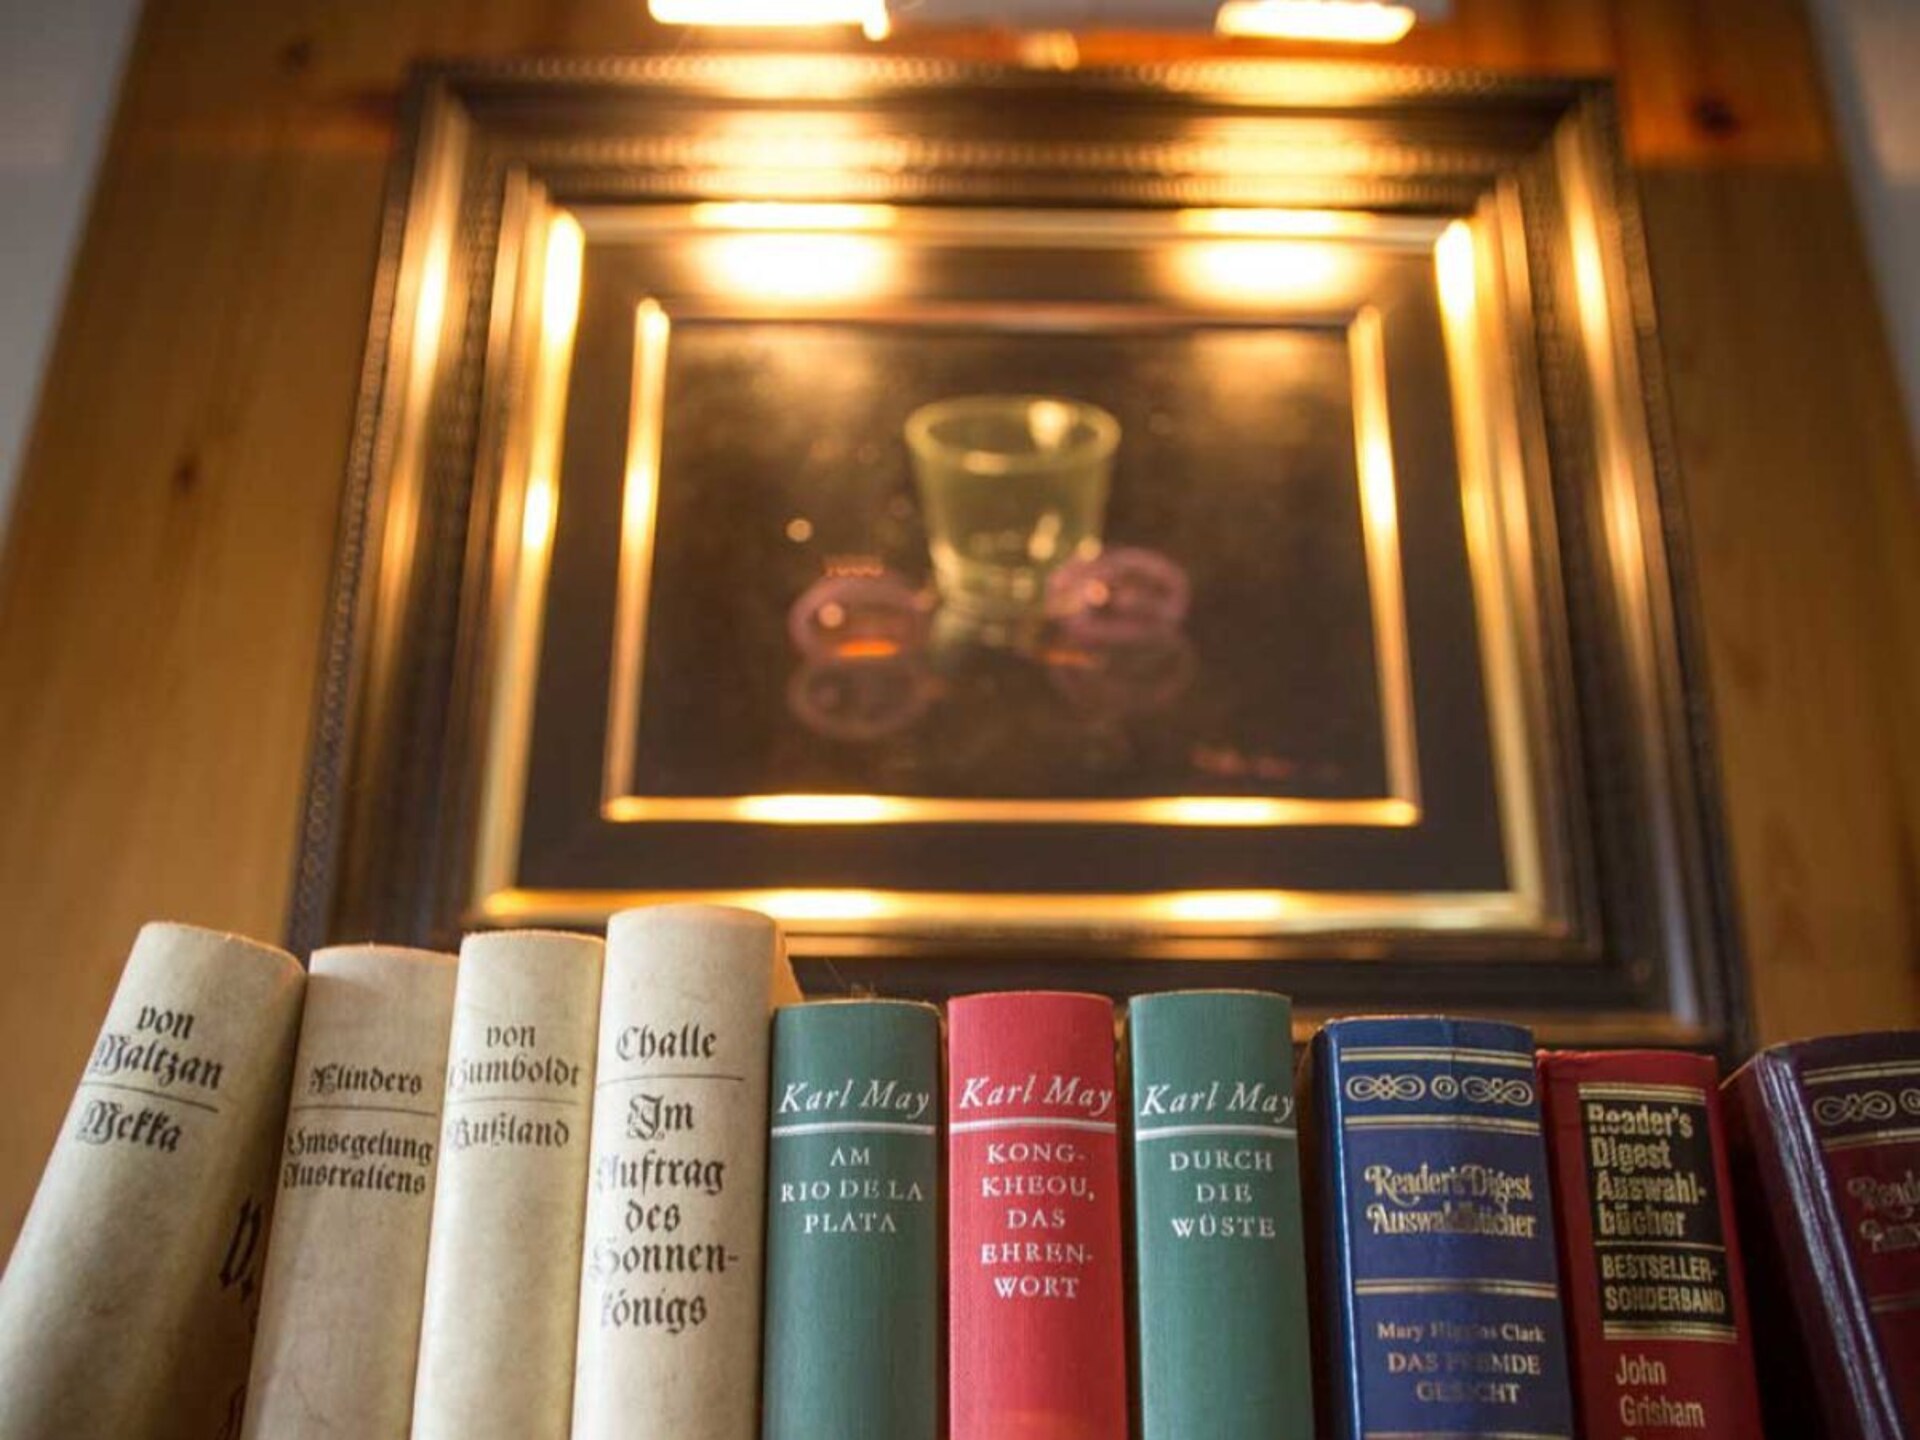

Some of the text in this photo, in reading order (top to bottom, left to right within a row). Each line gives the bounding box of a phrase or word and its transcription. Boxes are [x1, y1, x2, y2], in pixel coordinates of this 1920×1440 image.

[136, 1005, 195, 1041] von
[486, 1025, 536, 1048] von
[616, 1024, 717, 1062] Challe
[90, 1033, 223, 1090] Maltzan
[308, 1062, 423, 1096] Flinders
[958, 1074, 1113, 1117] Karl May
[777, 1078, 930, 1119] Karl May
[1139, 1080, 1295, 1124] Karl May
[75, 1099, 182, 1154] Mekka
[627, 1093, 694, 1141] Im
[1587, 1102, 1694, 1139] Reader's
[829, 1146, 871, 1167] AM
[987, 1142, 1087, 1165] KONG-
[1169, 1150, 1274, 1173] DURCH
[1590, 1134, 1673, 1173] Digest
[781, 1178, 925, 1203] RIO DE LA
[1196, 1182, 1253, 1203] DIE
[1461, 1162, 1533, 1214] Digest
[1596, 1169, 1708, 1204] Auswahl-
[625, 1199, 681, 1233] des
[803, 1212, 897, 1235] PLATA
[1007, 1207, 1067, 1230] DAS
[1171, 1213, 1277, 1239] WÜSTE
[1366, 1200, 1537, 1239] Auswahücher
[1599, 1202, 1686, 1236] bücher
[980, 1242, 1094, 1265] EHREN-
[993, 1275, 1080, 1299] WORT
[1604, 1284, 1726, 1314] SONDERBAND
[1377, 1320, 1547, 1344] Mary Hins Clark
[1387, 1351, 1542, 1376] DAS FMDE
[1615, 1353, 1668, 1386] John
[1415, 1379, 1521, 1405] GECHT
[1619, 1393, 1707, 1429] Grisham
